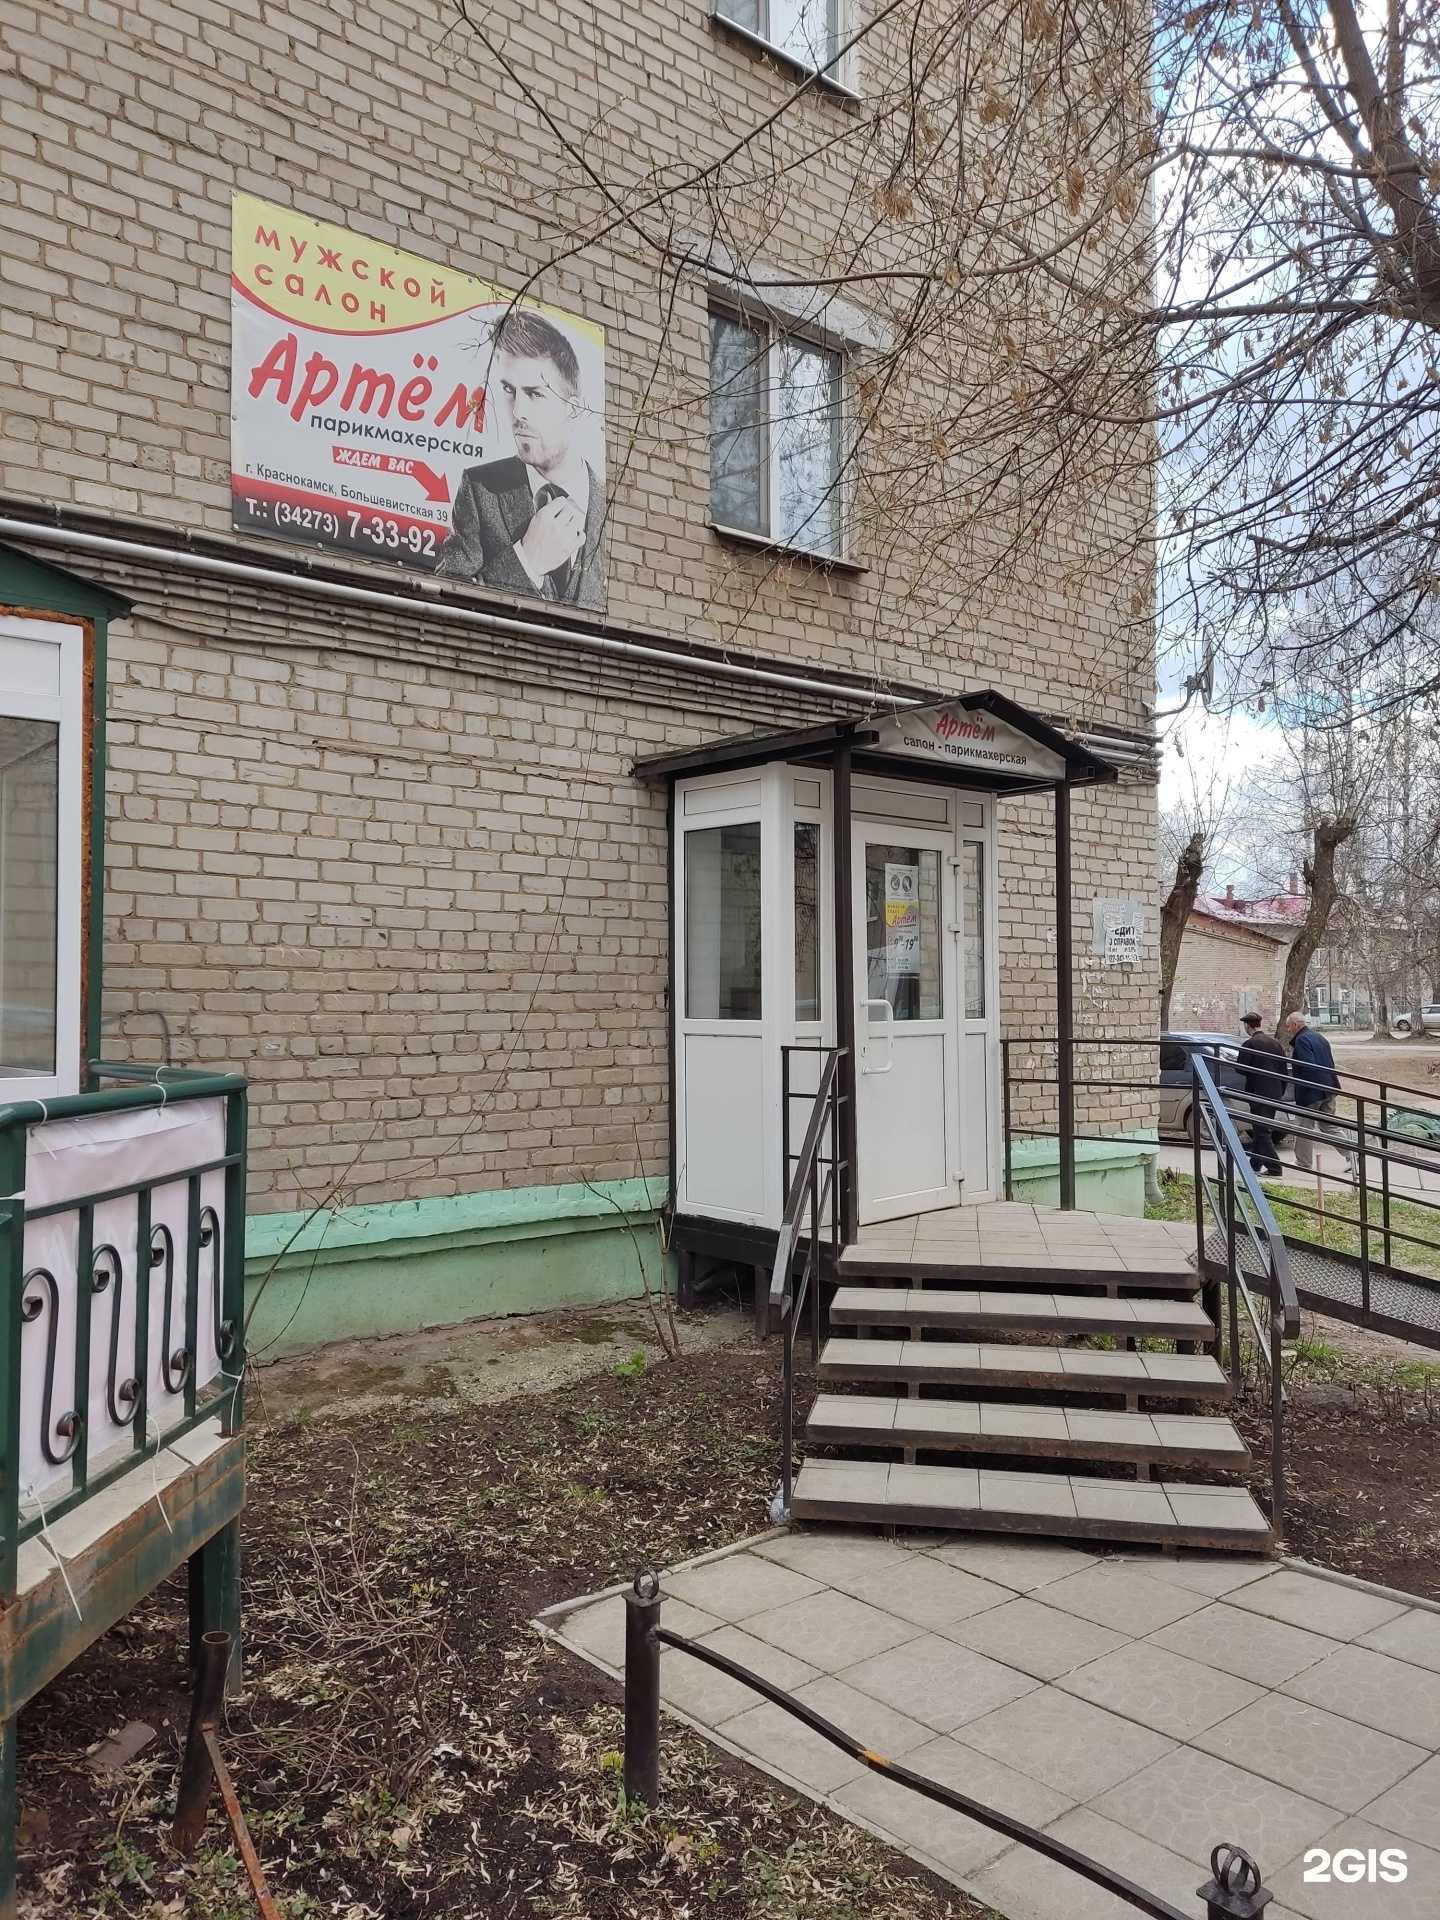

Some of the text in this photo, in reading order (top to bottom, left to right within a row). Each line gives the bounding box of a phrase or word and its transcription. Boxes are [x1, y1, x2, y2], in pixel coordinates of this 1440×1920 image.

[248, 332, 488, 434] Артём
[310, 414, 484, 459] парикмахерская
[335, 448, 416, 475] ЖДЕМ ВАС
[245, 463, 449, 523] г. Краснокамск, Большевистская 39
[274, 500, 340, 540] (34273)
[346, 510, 437, 557] 7-33-92
[935, 711, 996, 743] Артём
[903, 735, 935, 751] салон
[944, 743, 1027, 766] парикмахерская
